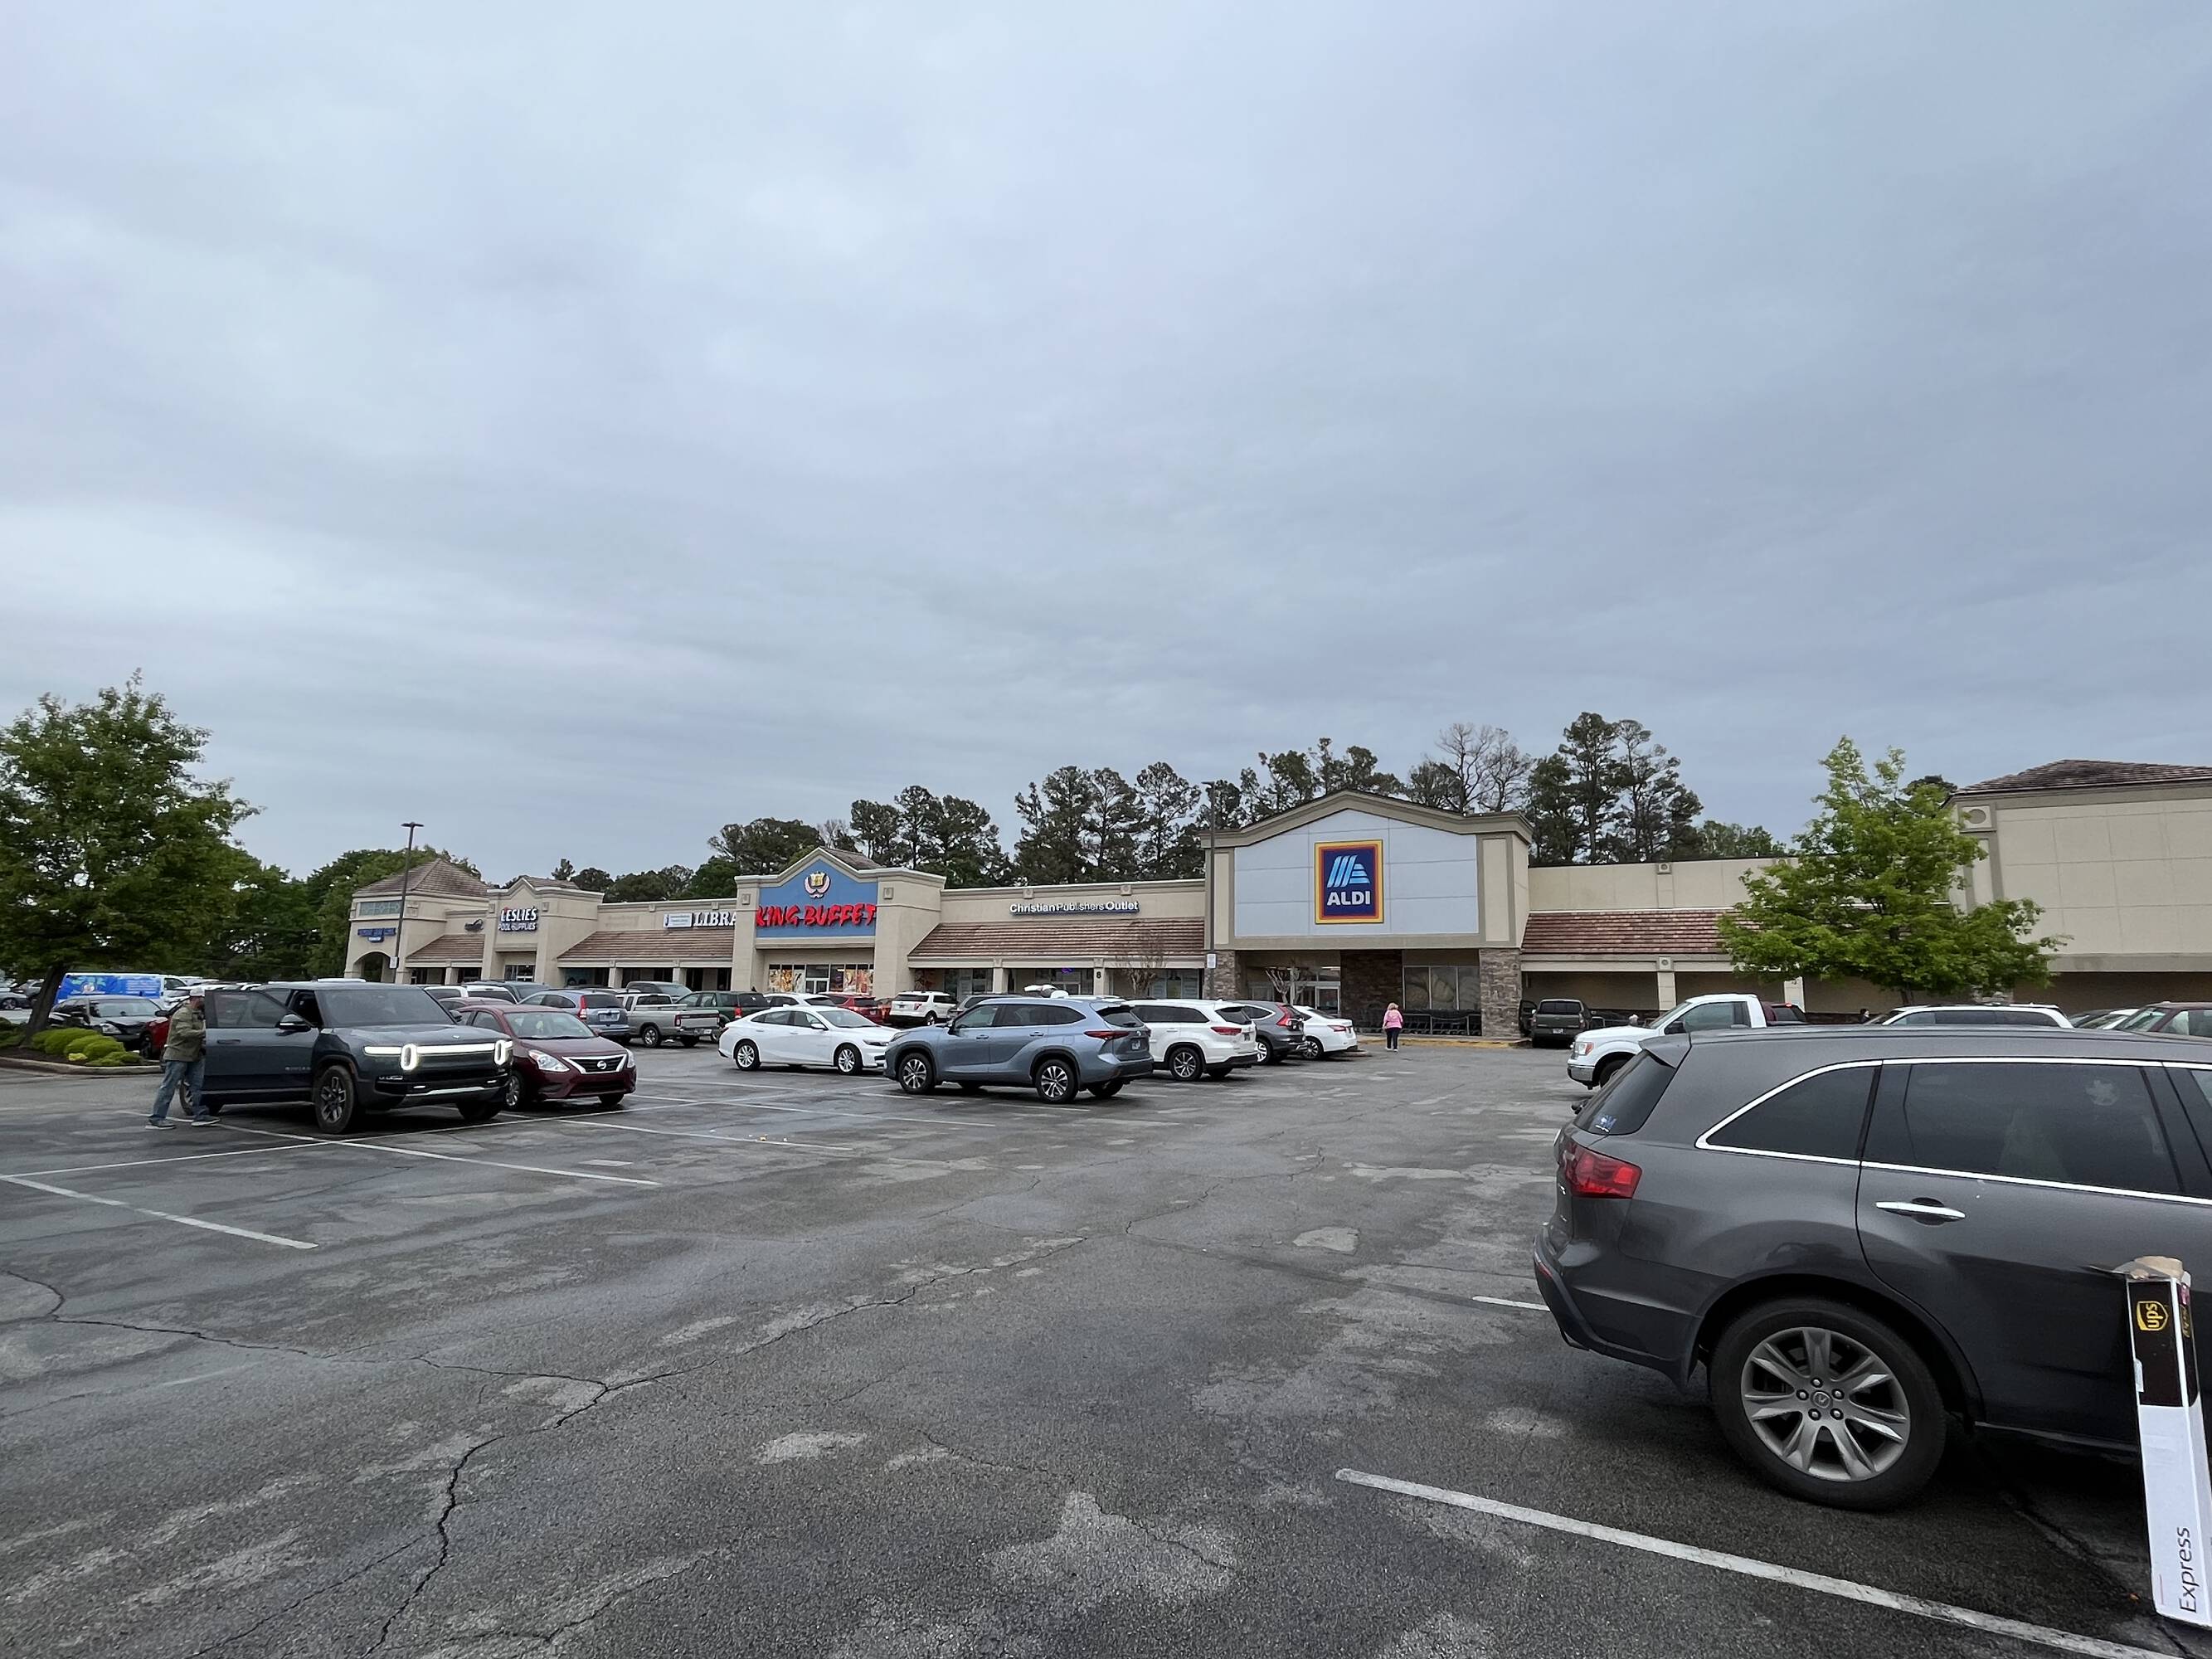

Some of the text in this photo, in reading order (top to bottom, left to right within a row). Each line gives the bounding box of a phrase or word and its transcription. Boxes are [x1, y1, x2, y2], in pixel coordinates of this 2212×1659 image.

[1009, 900, 1139, 912] Christian Publishers Outlet
[1327, 891, 1371, 906] ALDI
[756, 903, 877, 927] KING BUFFET
[1096, 971, 1102, 979] 8
[2145, 1303, 2164, 1328] ups
[2176, 1526, 2200, 1613] Express
